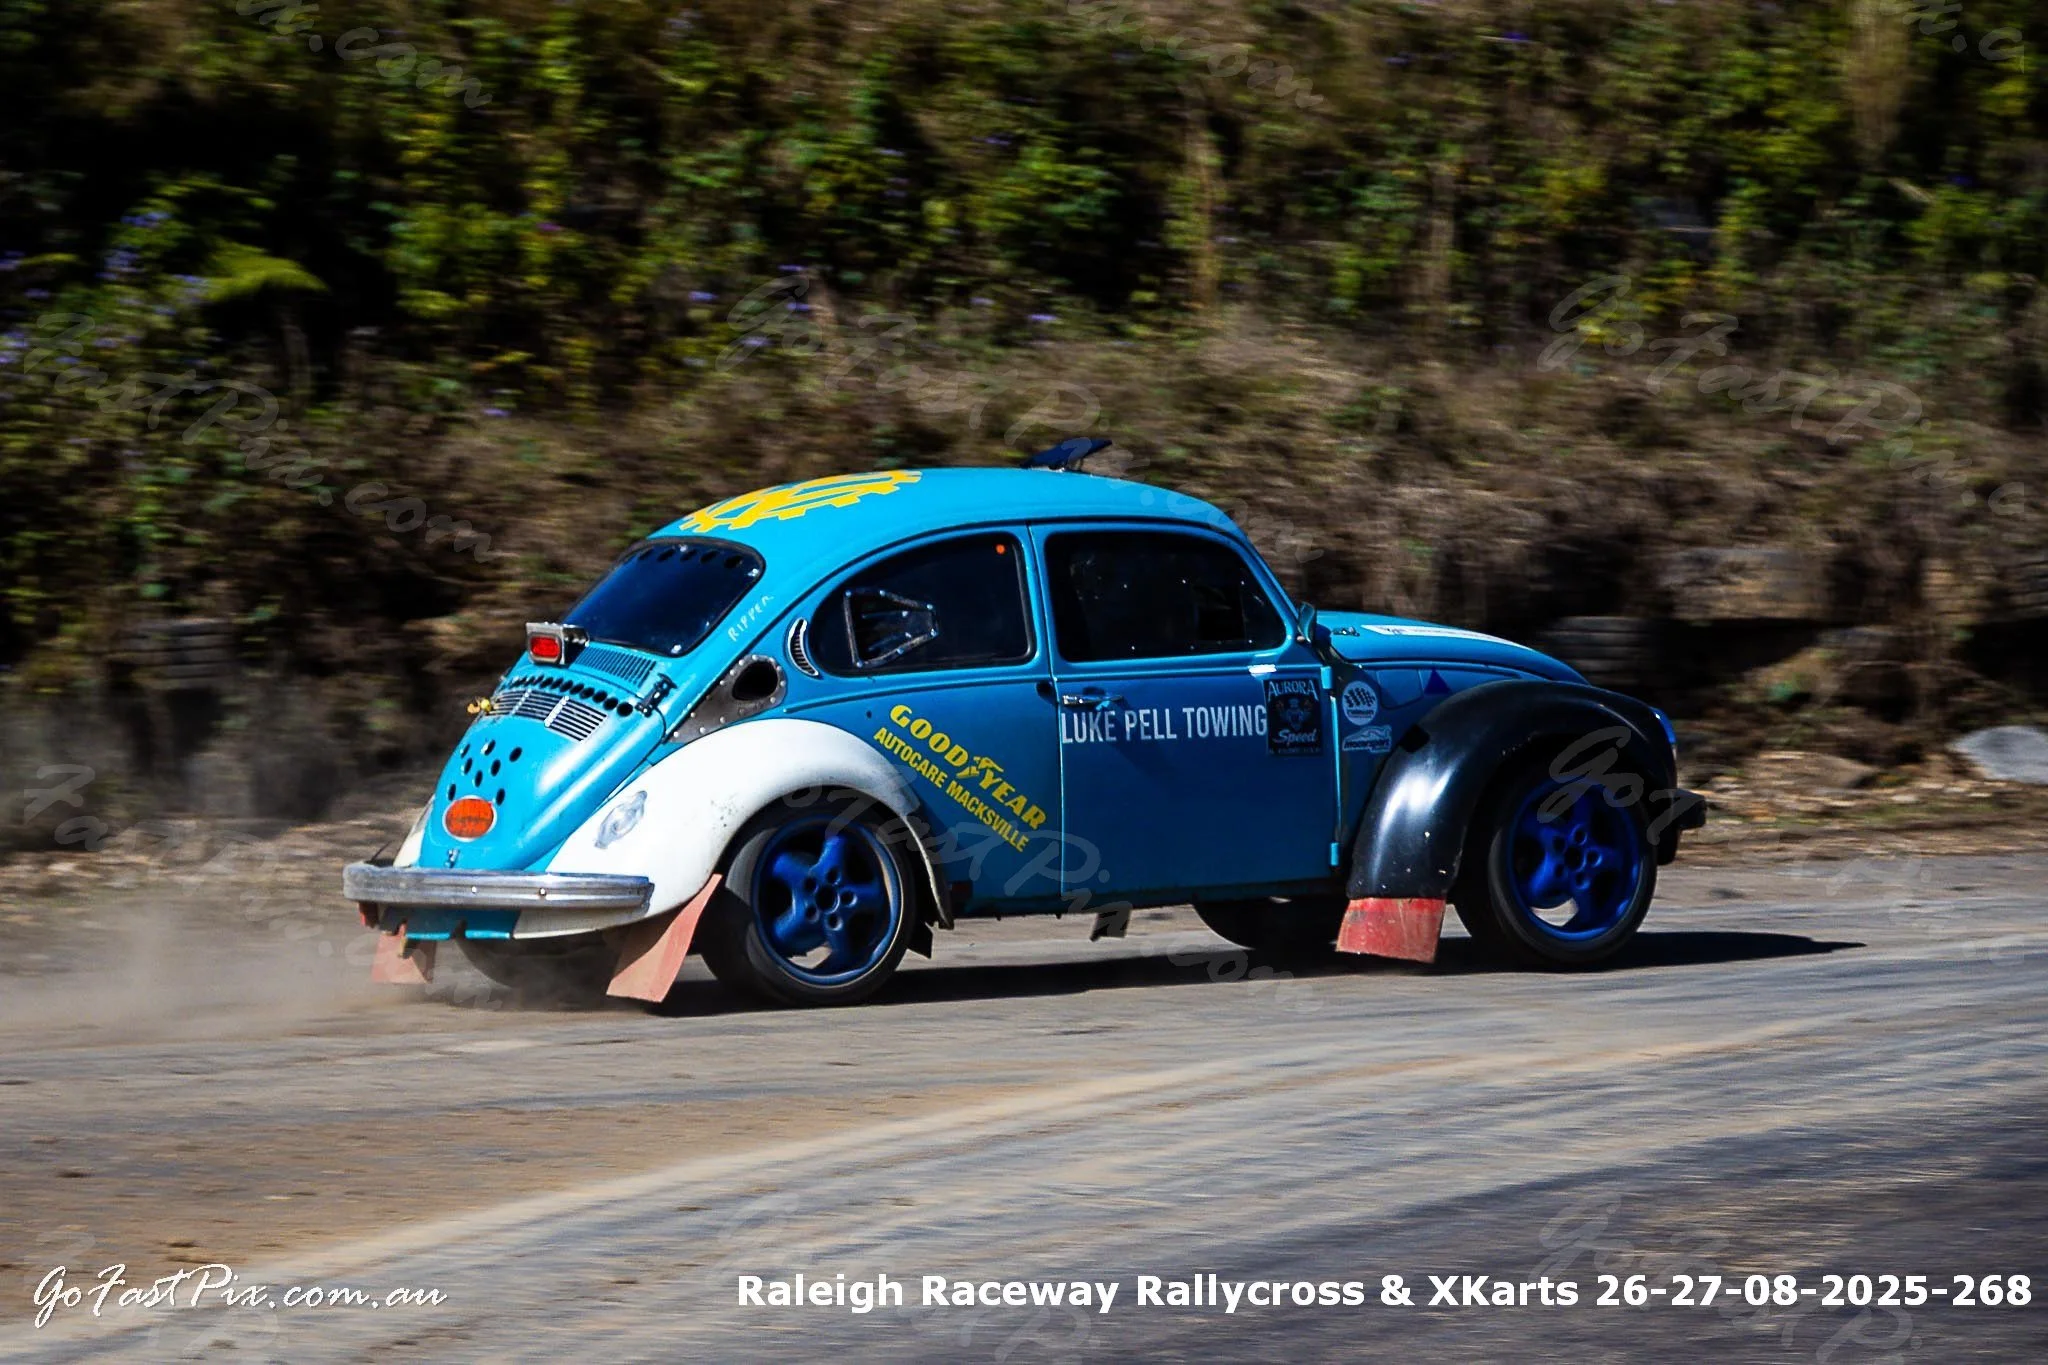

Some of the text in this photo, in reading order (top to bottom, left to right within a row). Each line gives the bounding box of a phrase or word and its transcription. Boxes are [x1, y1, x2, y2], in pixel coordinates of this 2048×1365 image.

[1267, 680, 1319, 702] AURORA
[1061, 704, 1268, 744] LUKE PELL TOWING
[1272, 728, 1318, 747] Speed
[889, 704, 1047, 830] GOODYEAR
[873, 727, 1029, 852] AUTOCARE MACKSVILLE
